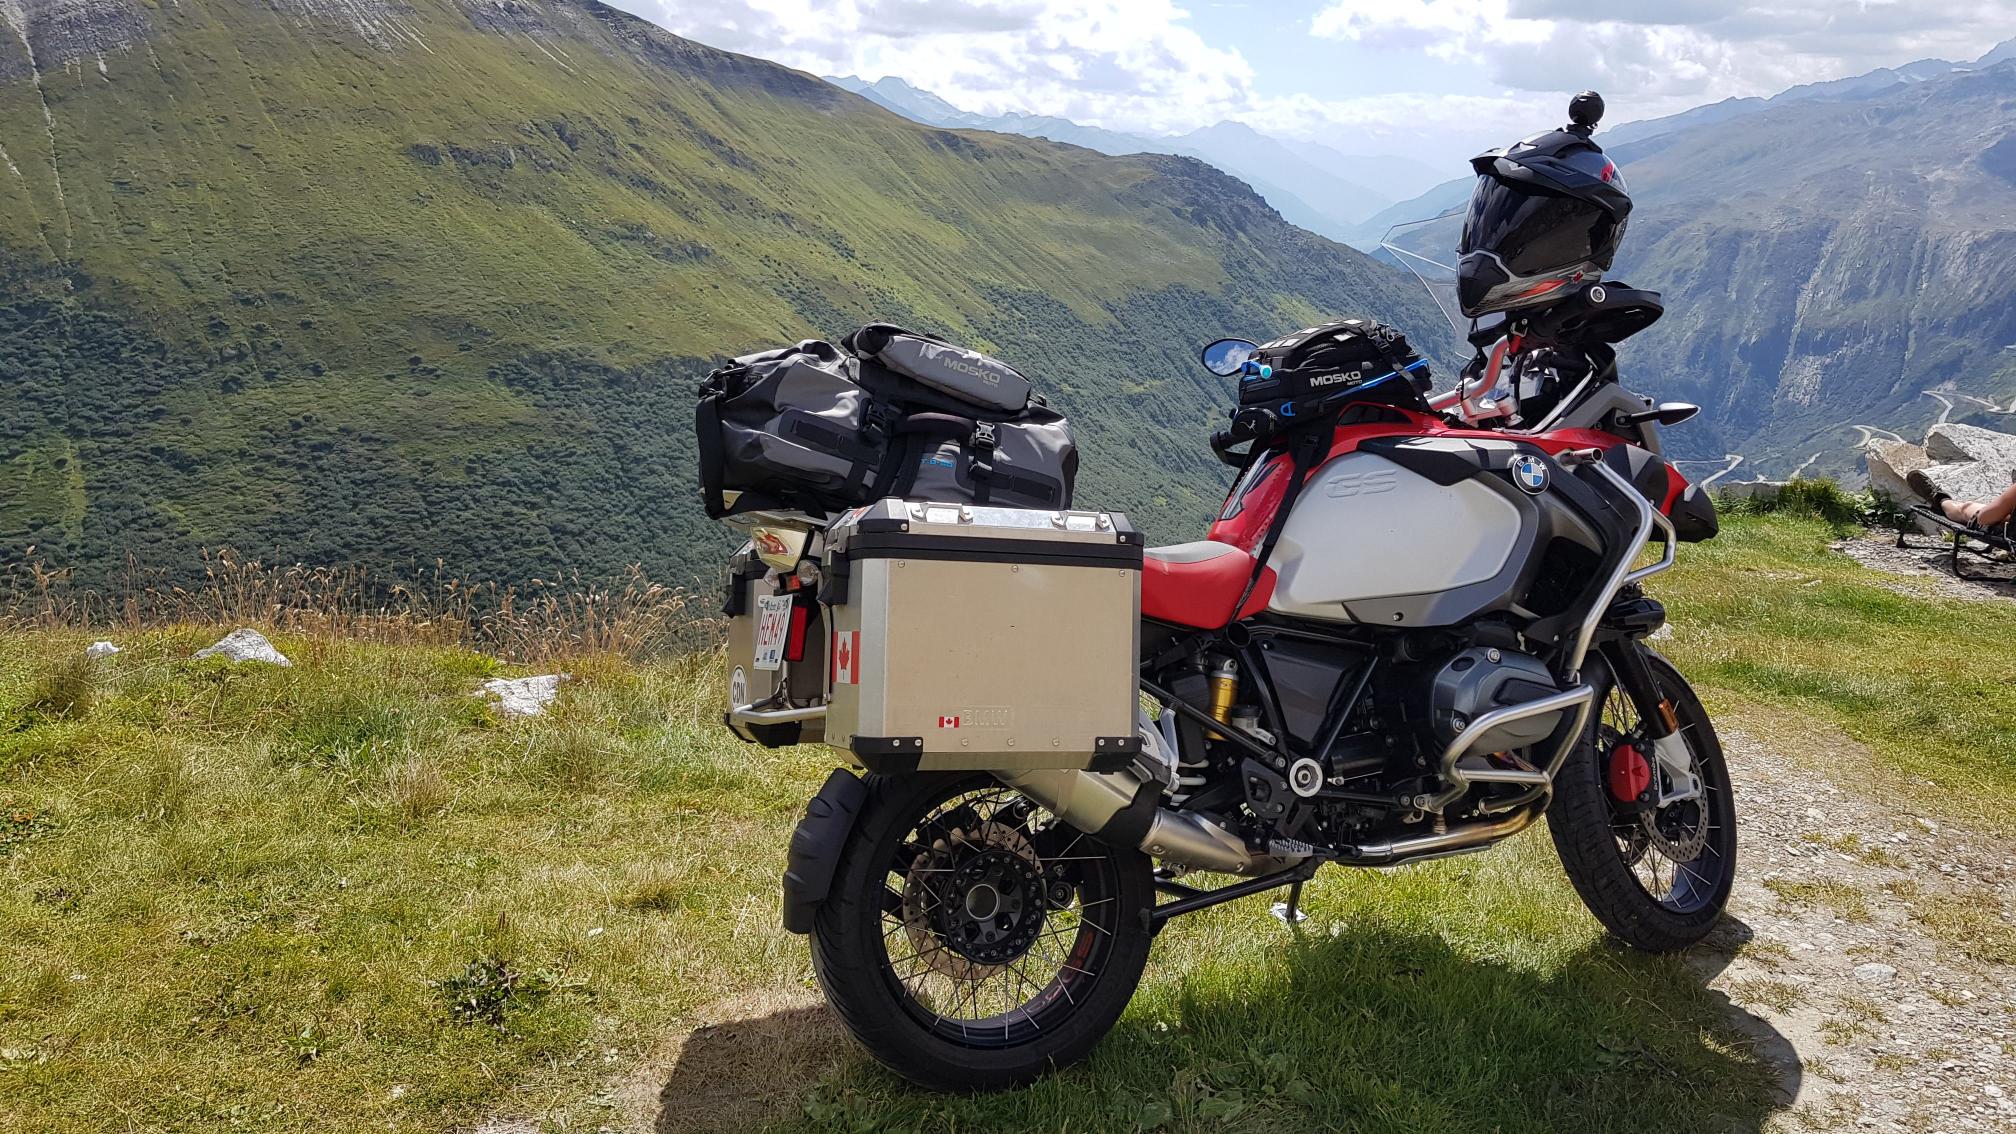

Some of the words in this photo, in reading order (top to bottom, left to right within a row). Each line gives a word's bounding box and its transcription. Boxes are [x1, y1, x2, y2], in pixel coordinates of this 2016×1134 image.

[944, 357, 1001, 383] MOSKO
[1310, 371, 1361, 387] MOSKO
[1516, 456, 1547, 470] BMW
[1326, 469, 1398, 499] GS
[733, 680, 745, 704] CDN
